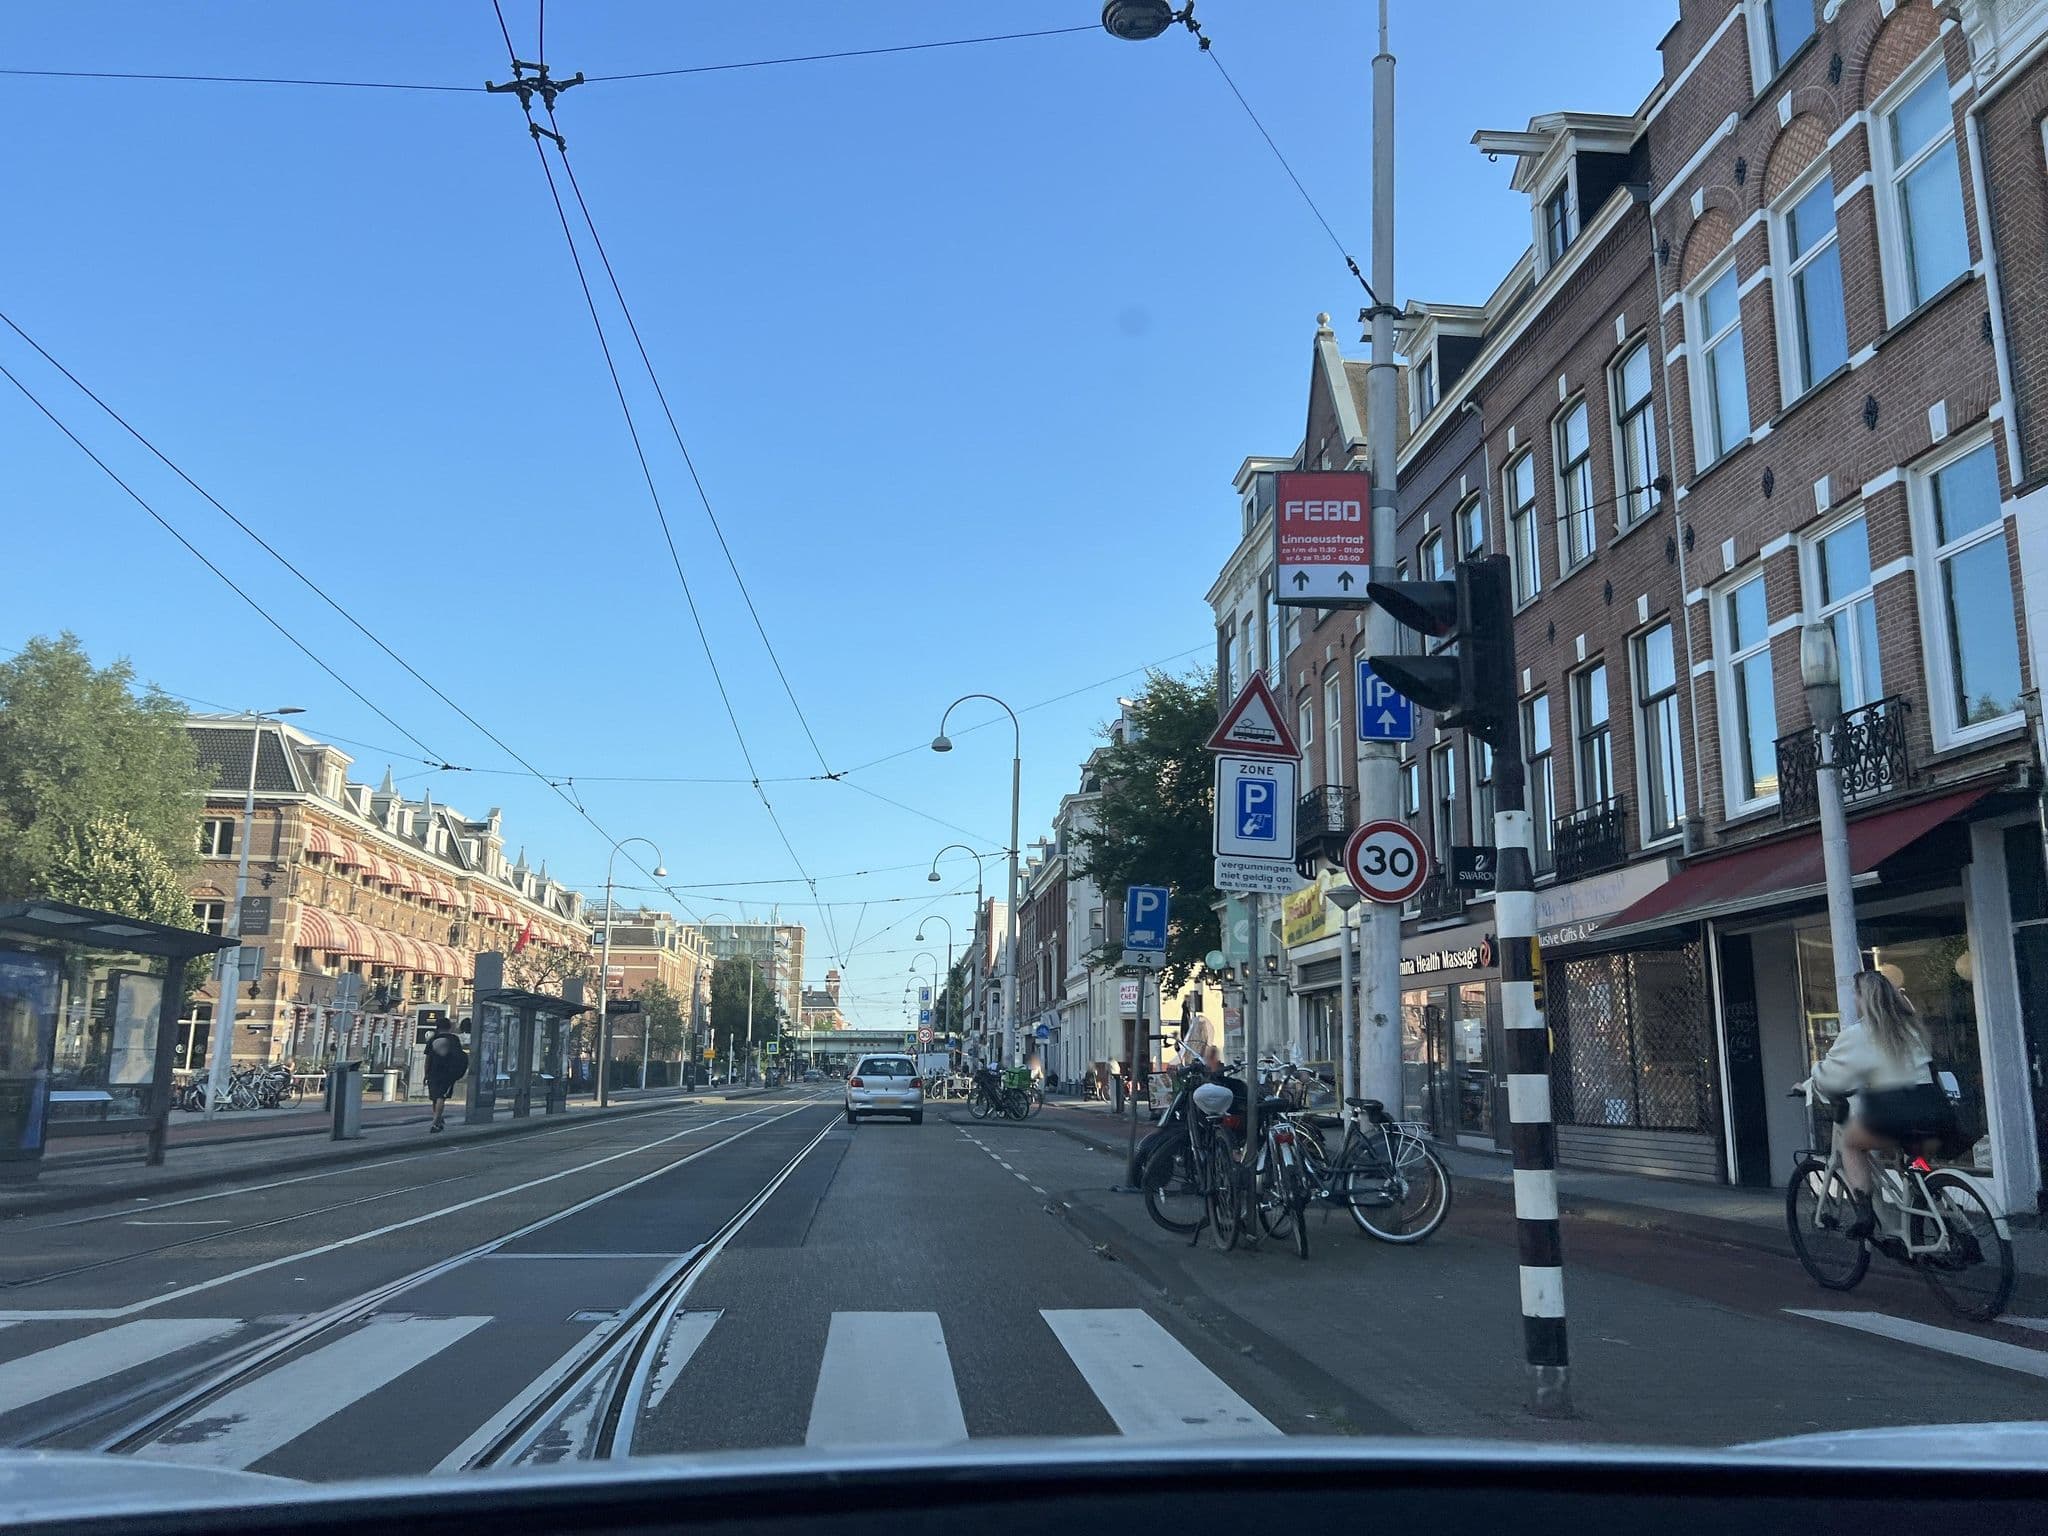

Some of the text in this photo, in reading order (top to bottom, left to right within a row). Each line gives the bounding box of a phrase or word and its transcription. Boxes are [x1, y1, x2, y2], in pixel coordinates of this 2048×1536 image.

[1285, 501, 1361, 522] FEBO
[1281, 534, 1365, 544] Linnaeusstraat
[1240, 764, 1274, 776] ZONE
[1245, 783, 1268, 813] P
[1221, 862, 1292, 873] vergunningen
[1363, 845, 1414, 878] 30
[1221, 872, 1240, 880] niet
[1242, 874, 1273, 883] geldig
[1459, 871, 1495, 880] SWARO
[1135, 891, 1159, 922] P
[1538, 932, 1559, 947] lusive
[1560, 927, 1578, 943] Gifts
[1579, 925, 1587, 940] &
[1137, 953, 1151, 963] 2x
[1399, 947, 1478, 976] hina Health Massage
[920, 1031, 930, 1039] 30
